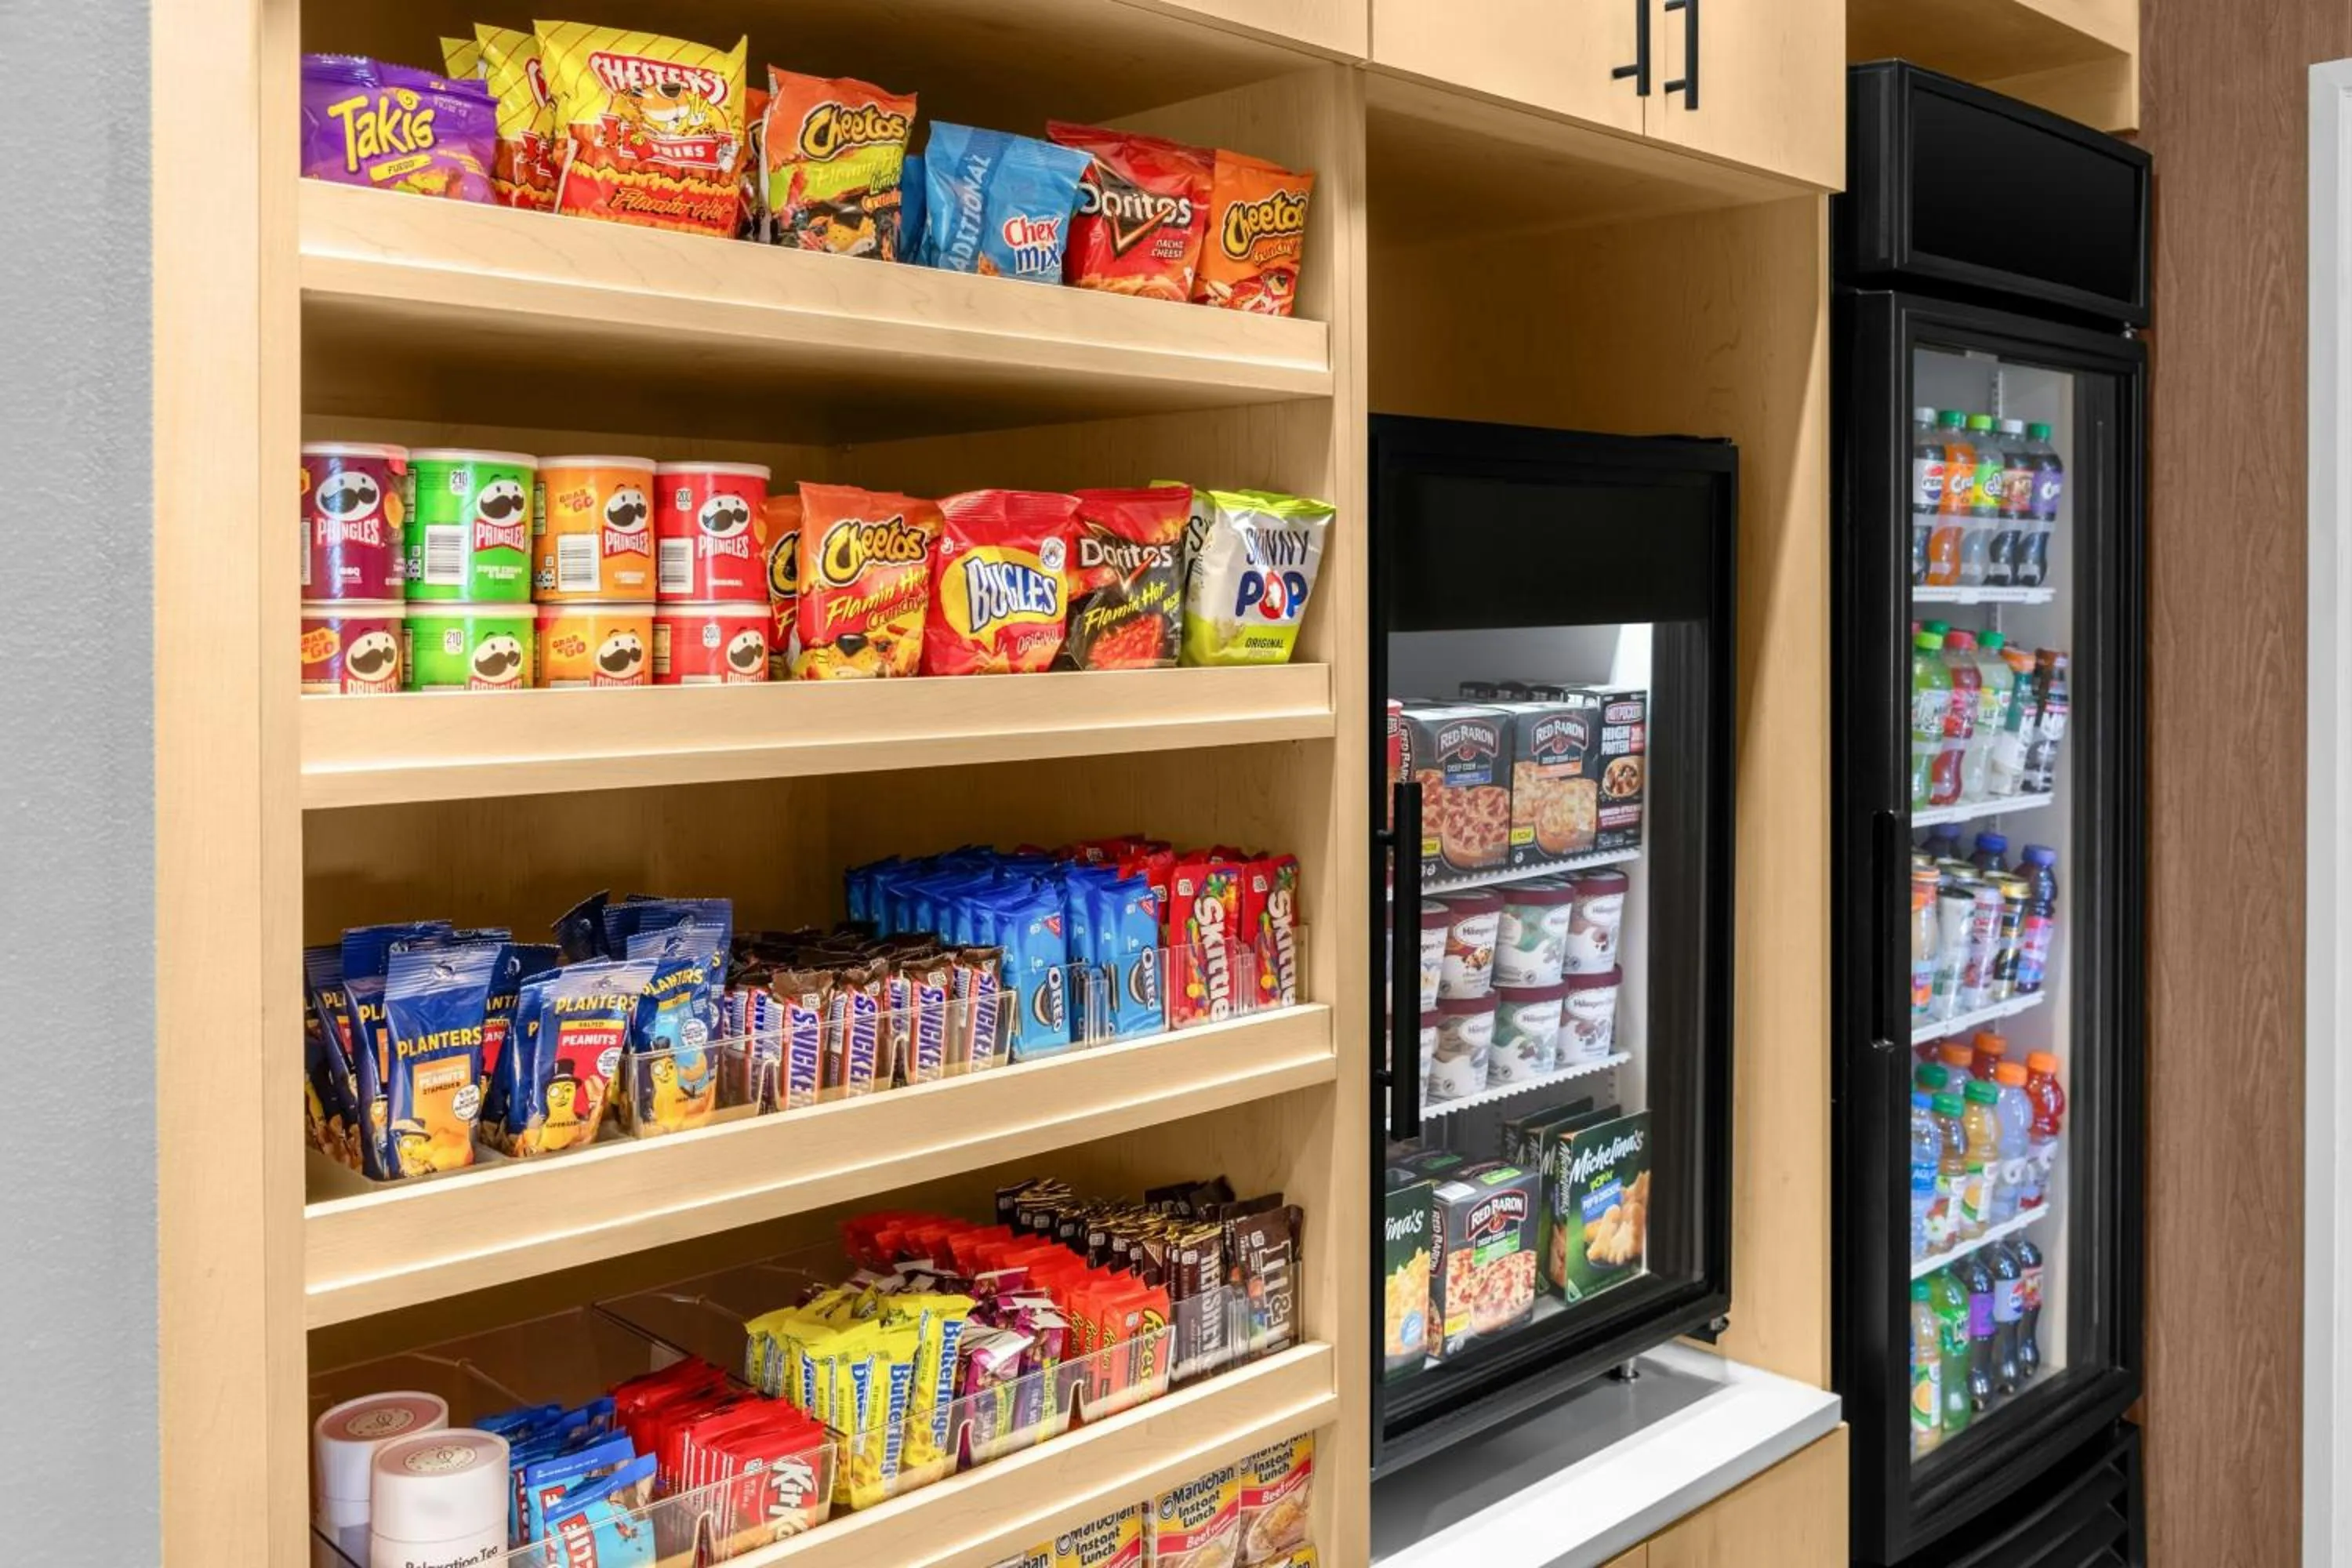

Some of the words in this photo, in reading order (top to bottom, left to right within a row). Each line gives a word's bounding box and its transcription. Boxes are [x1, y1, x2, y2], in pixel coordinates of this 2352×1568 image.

[590, 54, 727, 105] CHESTER'S
[327, 89, 436, 172] Takis
[803, 103, 906, 159] Cheetos
[387, 159, 416, 174] FUEGO
[947, 154, 992, 271] ADITIONAL
[1078, 182, 1192, 226] Doritos
[1003, 216, 1060, 246] Chex
[1223, 191, 1308, 258] Cheetos
[1151, 249, 1185, 260] CHEESE
[1156, 239, 1185, 249] NACHO
[572, 495, 593, 513] GO
[317, 517, 379, 546] PRINGLES
[476, 522, 524, 550] PRINGLES
[604, 528, 650, 555] PRINGLES
[1245, 527, 1310, 565] SKINNY
[698, 535, 750, 560] PRINGLES
[823, 517, 927, 584] Cheetos
[1080, 538, 1172, 570] Doritos
[964, 556, 1058, 633] BUGLES
[1236, 570, 1308, 620] POP
[446, 631, 462, 646] 210
[564, 641, 587, 658] GO
[1244, 637, 1285, 649] ORIGINAL
[1439, 729, 1461, 752] RED
[1461, 724, 1494, 747] BARON
[1535, 724, 1553, 745] RED
[1554, 719, 1585, 742] BARON
[1400, 751, 1410, 783] BARO
[1194, 896, 1229, 1022] Skittle
[1267, 889, 1296, 1007] Skittle
[1142, 947, 1156, 1011] OREO
[554, 995, 638, 1015] PLANTERS
[1047, 967, 1063, 1033] OREO
[397, 1025, 484, 1060] PLANTERS
[561, 1033, 618, 1047] PEANUTS
[1569, 1129, 1645, 1184] Michelina's
[1385, 1208, 1425, 1242] lina's
[1431, 1210, 1442, 1232] RED
[1472, 1204, 1491, 1230] RED
[1491, 1196, 1523, 1215] BARON
[1430, 1233, 1444, 1271] BARON
[1254, 1448, 1294, 1474] Instant
[1258, 1463, 1290, 1483] Lunch
[1173, 1466, 1235, 1504] Maruchan
[1178, 1490, 1221, 1519] Instant
[1183, 1504, 1216, 1529] Lunch
[479, 1545, 499, 1562] Tea
[1075, 1526, 1120, 1555] Instant
[1081, 1542, 1116, 1566] Lunch
